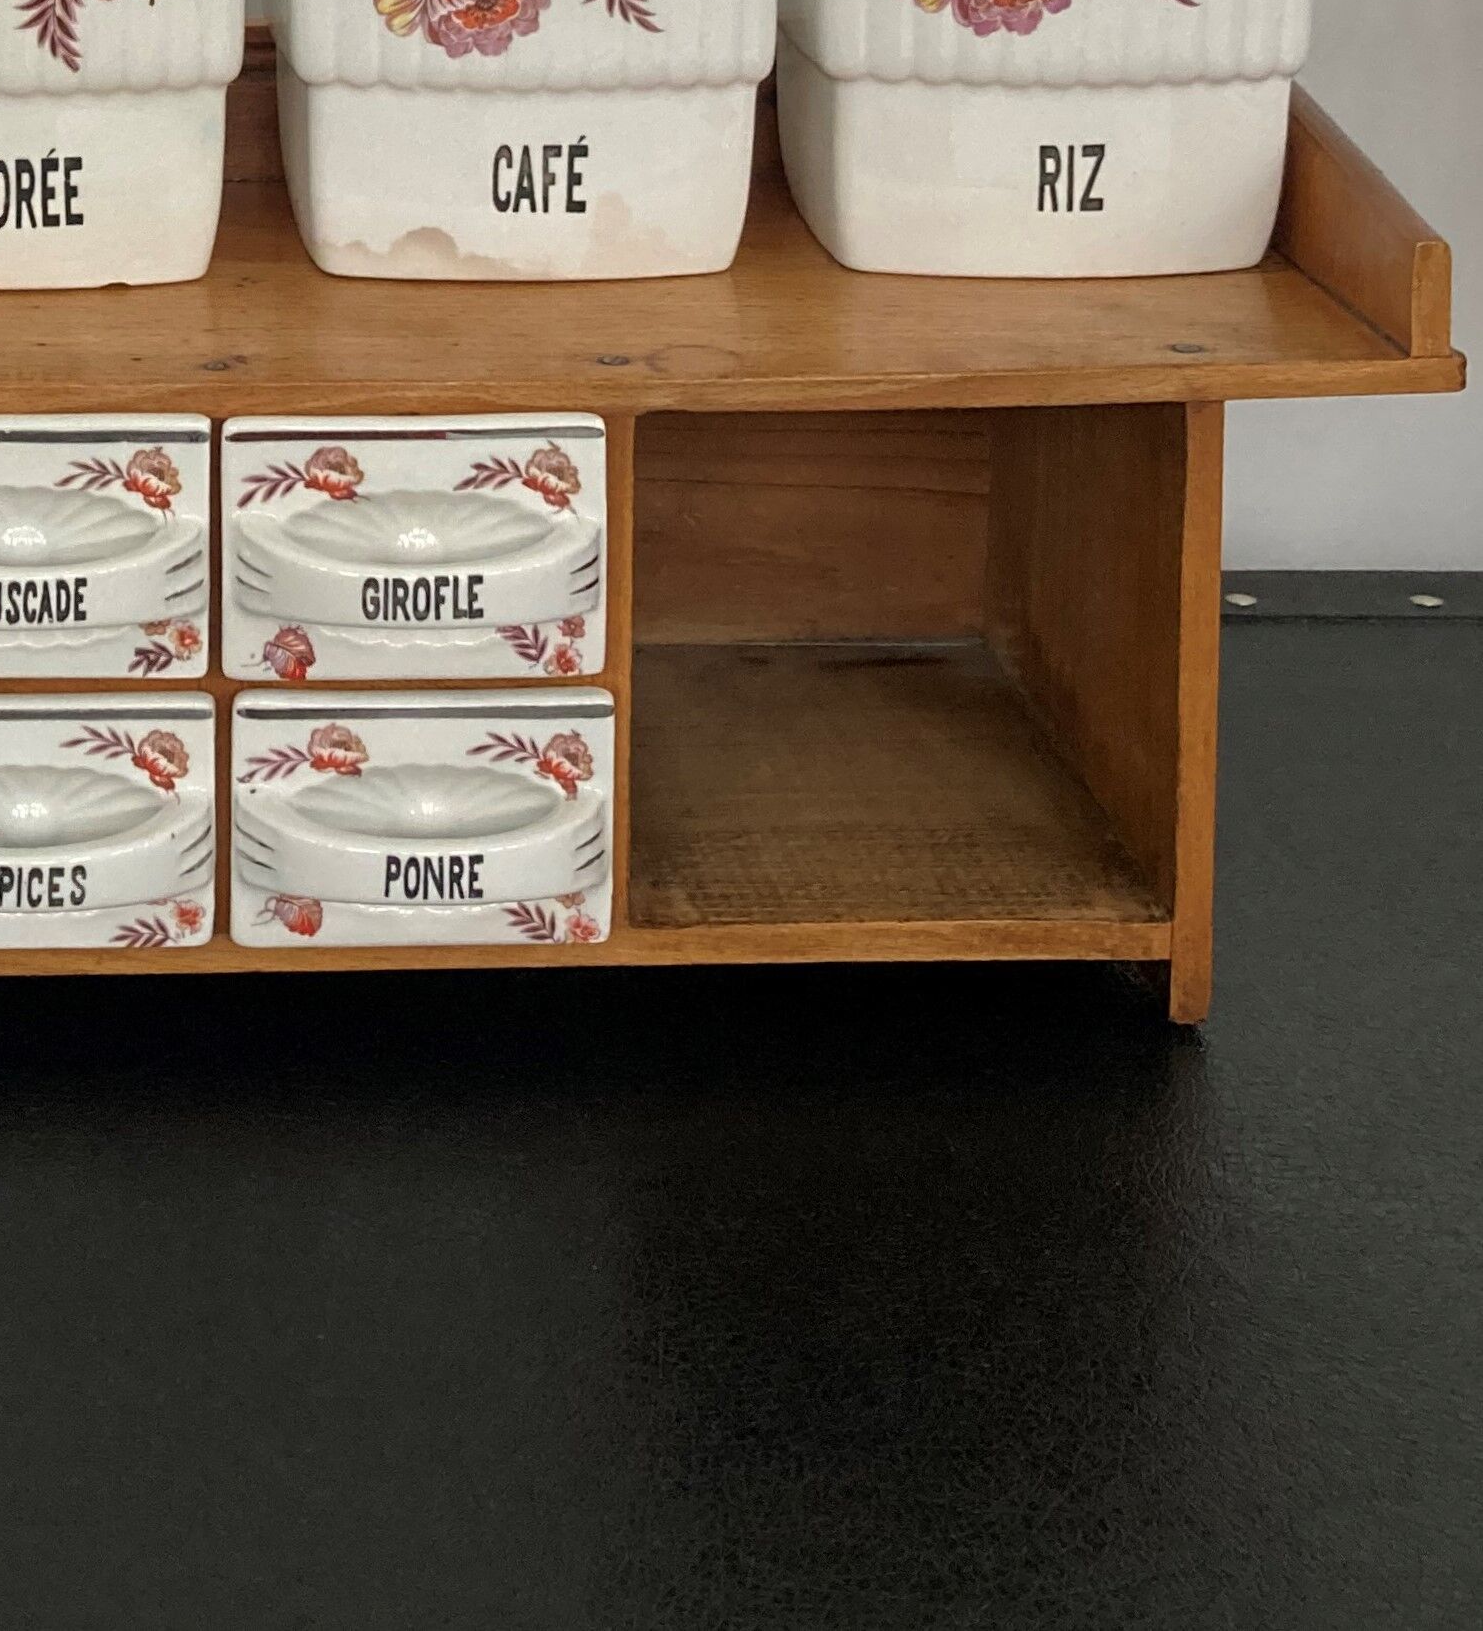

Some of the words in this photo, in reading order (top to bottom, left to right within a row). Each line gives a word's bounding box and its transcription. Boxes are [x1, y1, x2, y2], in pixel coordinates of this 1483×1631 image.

[492, 135, 590, 214] CAFÉ
[1037, 143, 1106, 213] RIZ
[361, 574, 484, 622] GIROFLE
[384, 854, 484, 900] PONRE
